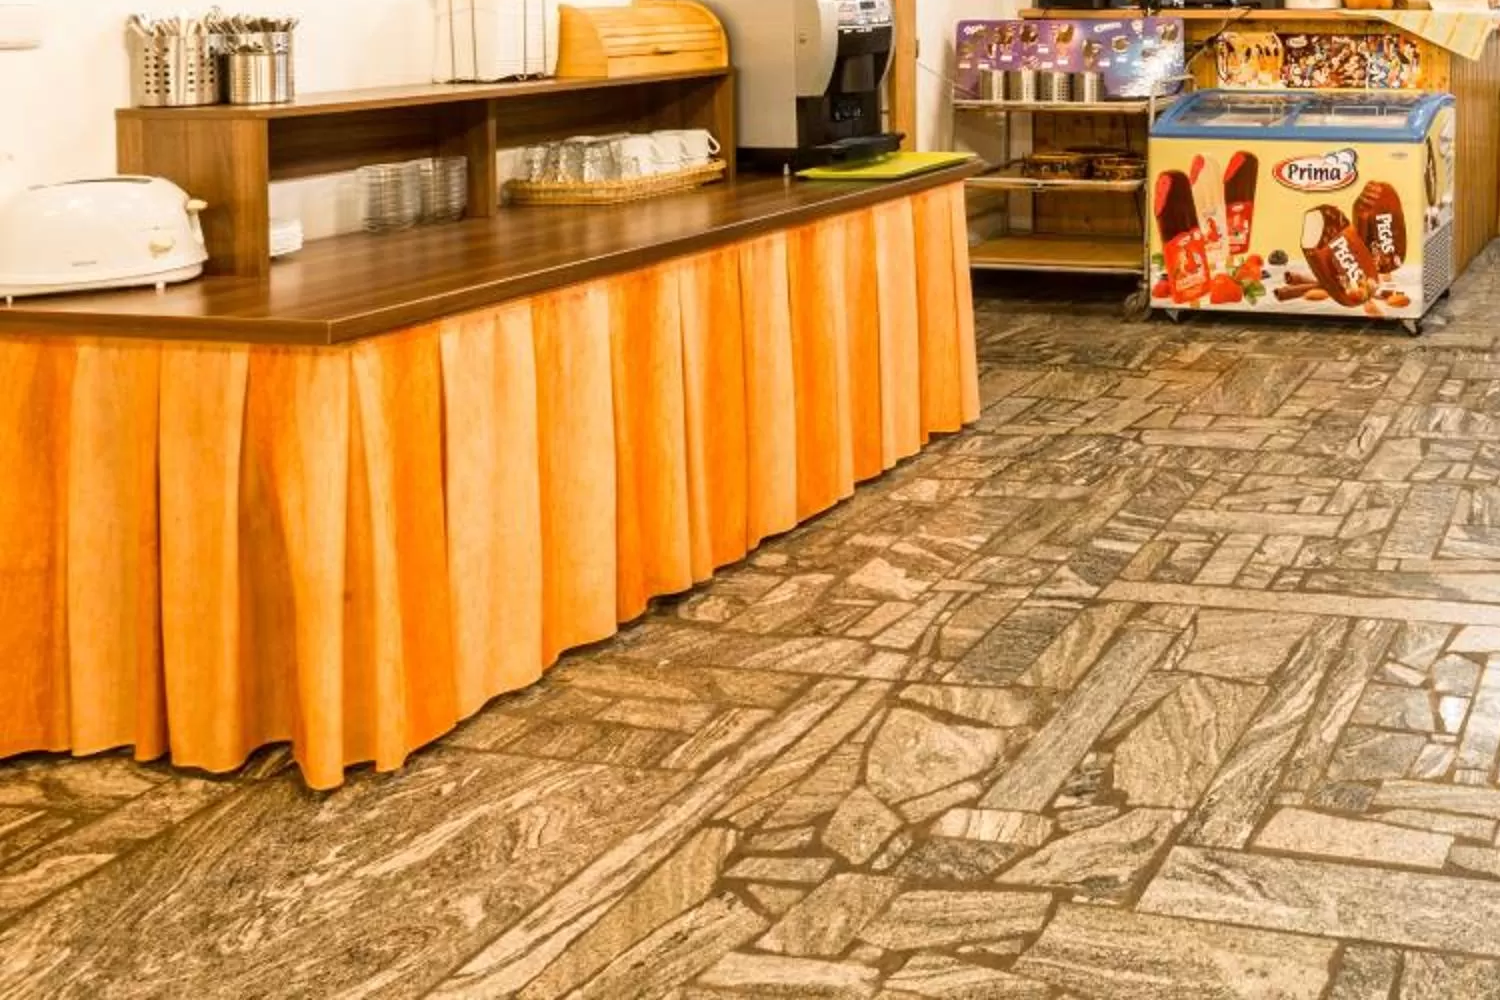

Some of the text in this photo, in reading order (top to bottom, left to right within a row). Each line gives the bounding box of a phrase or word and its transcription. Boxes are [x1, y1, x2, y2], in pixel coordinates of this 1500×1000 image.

[1287, 163, 1342, 181] Prima
[1375, 213, 1395, 255] PEGAS
[1327, 235, 1365, 283] PEGAS
